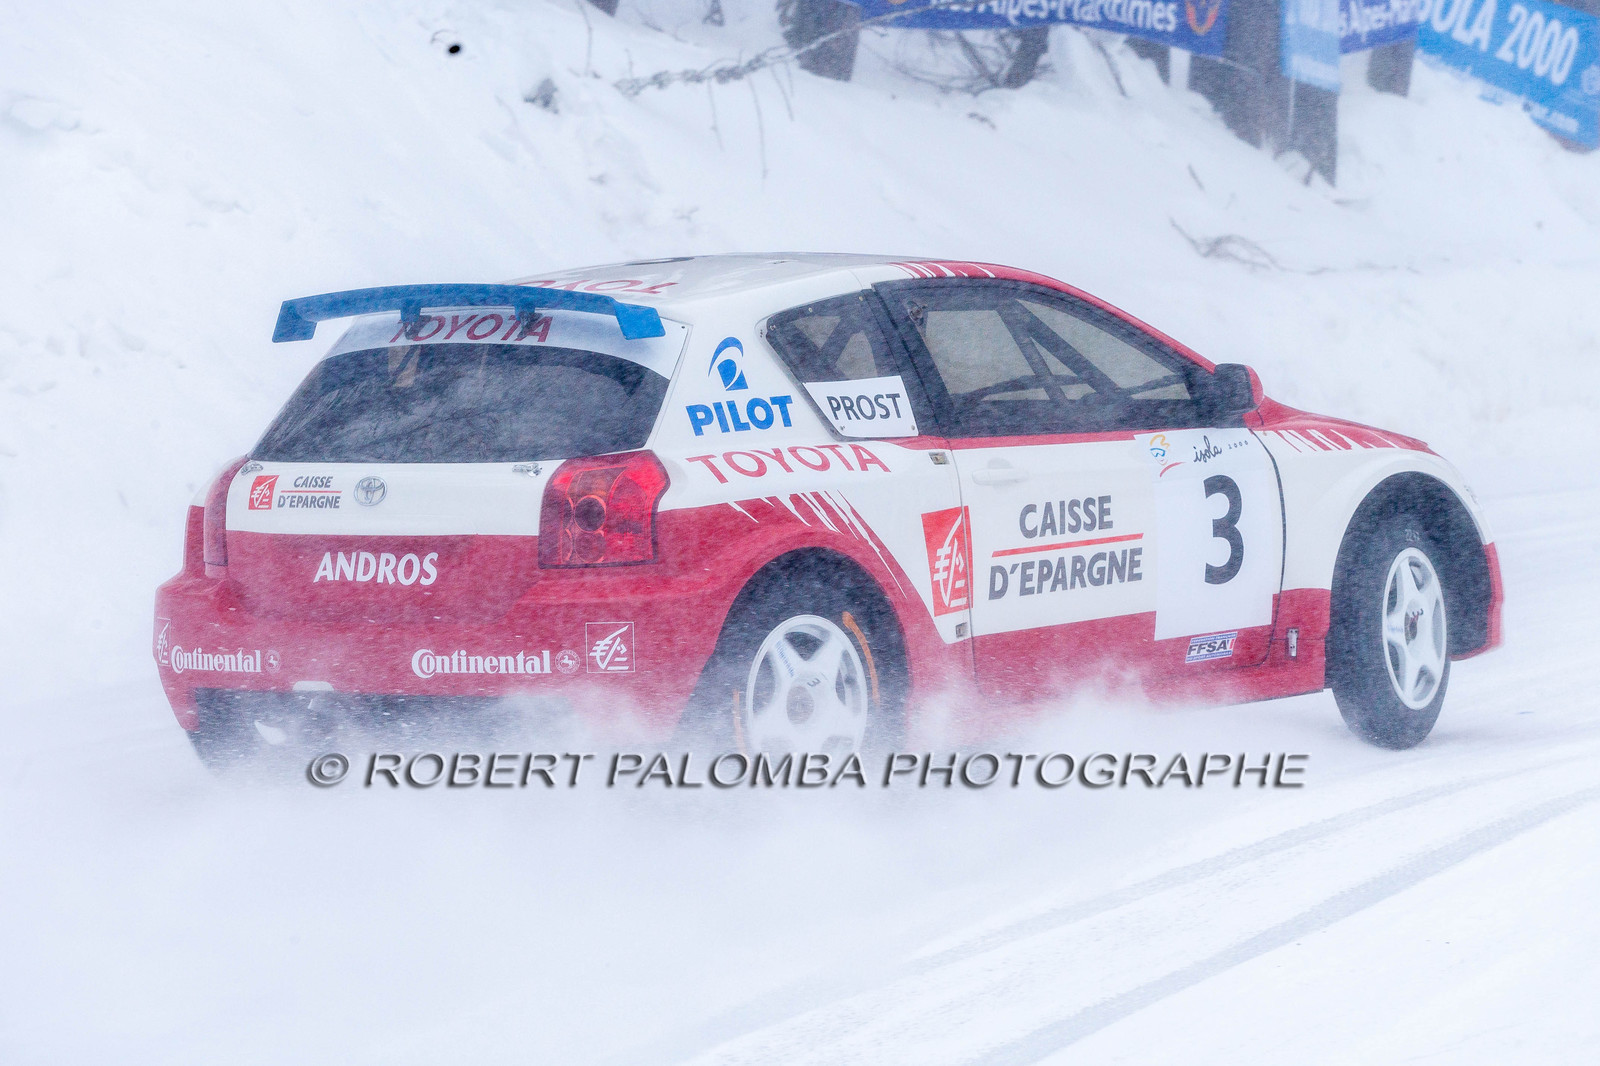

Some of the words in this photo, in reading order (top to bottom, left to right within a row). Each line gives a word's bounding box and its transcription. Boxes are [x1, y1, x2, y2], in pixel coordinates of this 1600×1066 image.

[1496, 4, 1578, 85] 2000
[389, 313, 554, 344] TOYOTA
[685, 395, 793, 437] PILOT
[826, 393, 902, 421] PROST
[685, 443, 892, 484] TOYOTA
[1193, 435, 1223, 463] isola
[293, 475, 334, 489] CAISSE
[277, 495, 341, 509] D'EPARGNE
[1019, 494, 1114, 539] CAISSE
[1203, 474, 1245, 585] 3
[313, 551, 439, 586] ANDROS
[988, 547, 1143, 601] D'EPARGNE
[170, 645, 262, 674] Continental
[1187, 639, 1228, 656] FFSA
[411, 648, 552, 679] Continental
